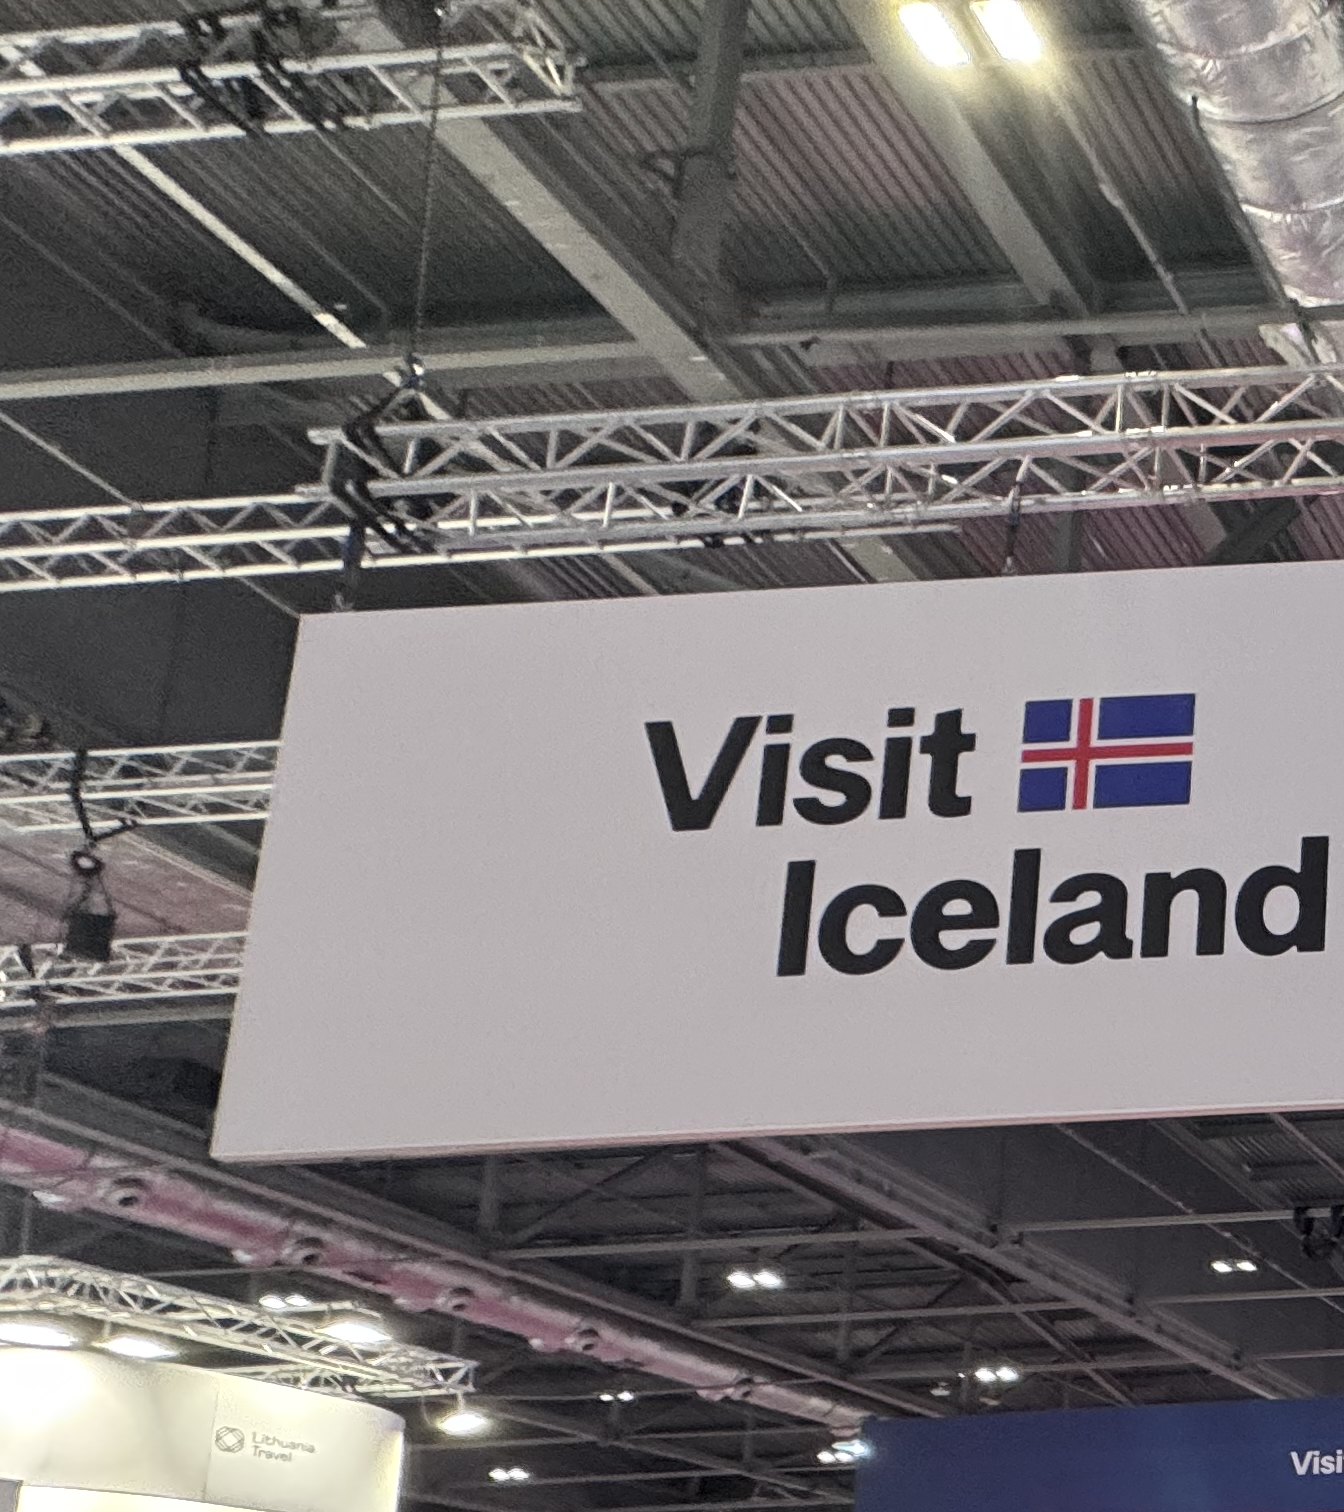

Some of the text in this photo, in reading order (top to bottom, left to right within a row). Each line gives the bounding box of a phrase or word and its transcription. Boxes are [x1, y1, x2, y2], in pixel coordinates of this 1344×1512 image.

[644, 706, 977, 832] Visit
[776, 835, 1330, 977] Iceland
[252, 1444, 292, 1462] Travel
